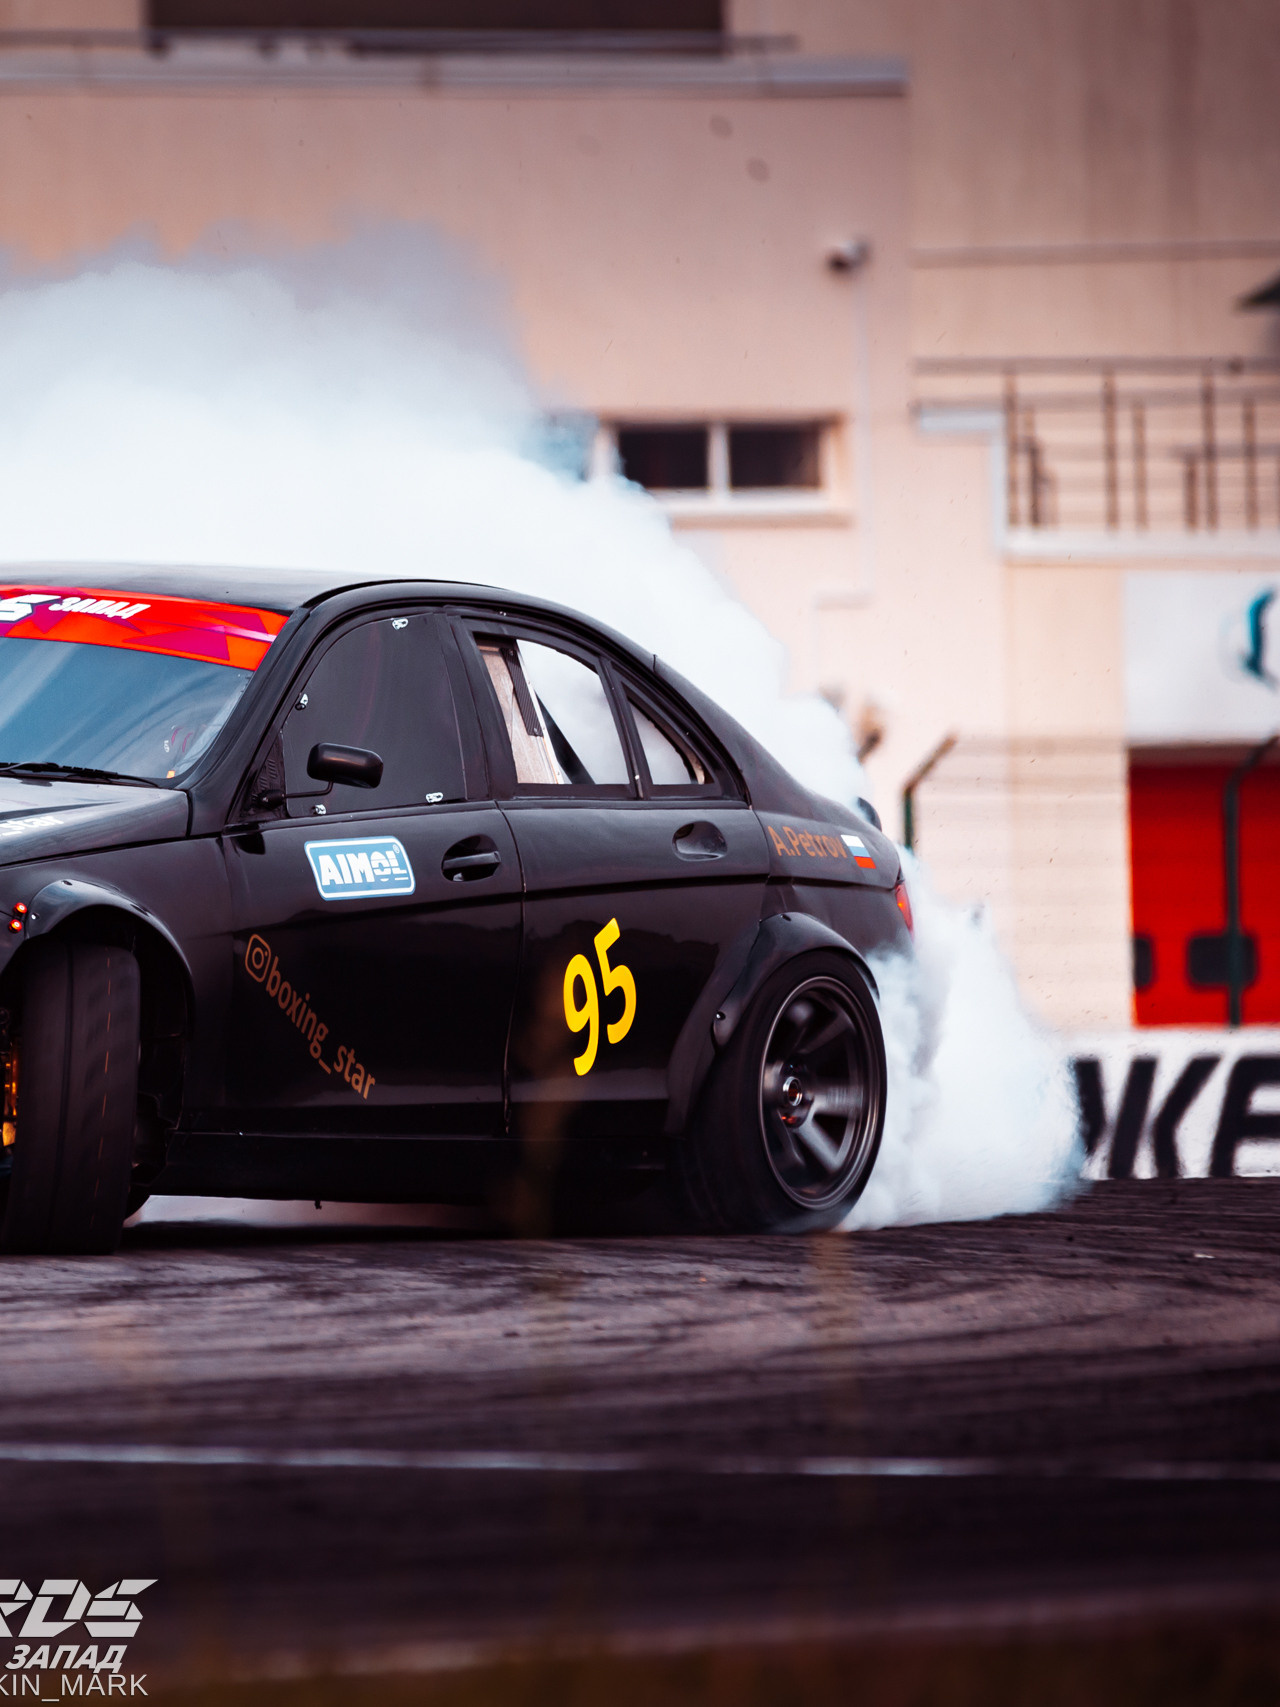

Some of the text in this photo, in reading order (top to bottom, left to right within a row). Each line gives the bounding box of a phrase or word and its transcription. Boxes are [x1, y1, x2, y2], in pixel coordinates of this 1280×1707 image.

[318, 850, 409, 886] AIMOL
[768, 825, 848, 859] A.Petrov
[266, 955, 376, 1100] boxing_star
[563, 917, 637, 1076] 95
